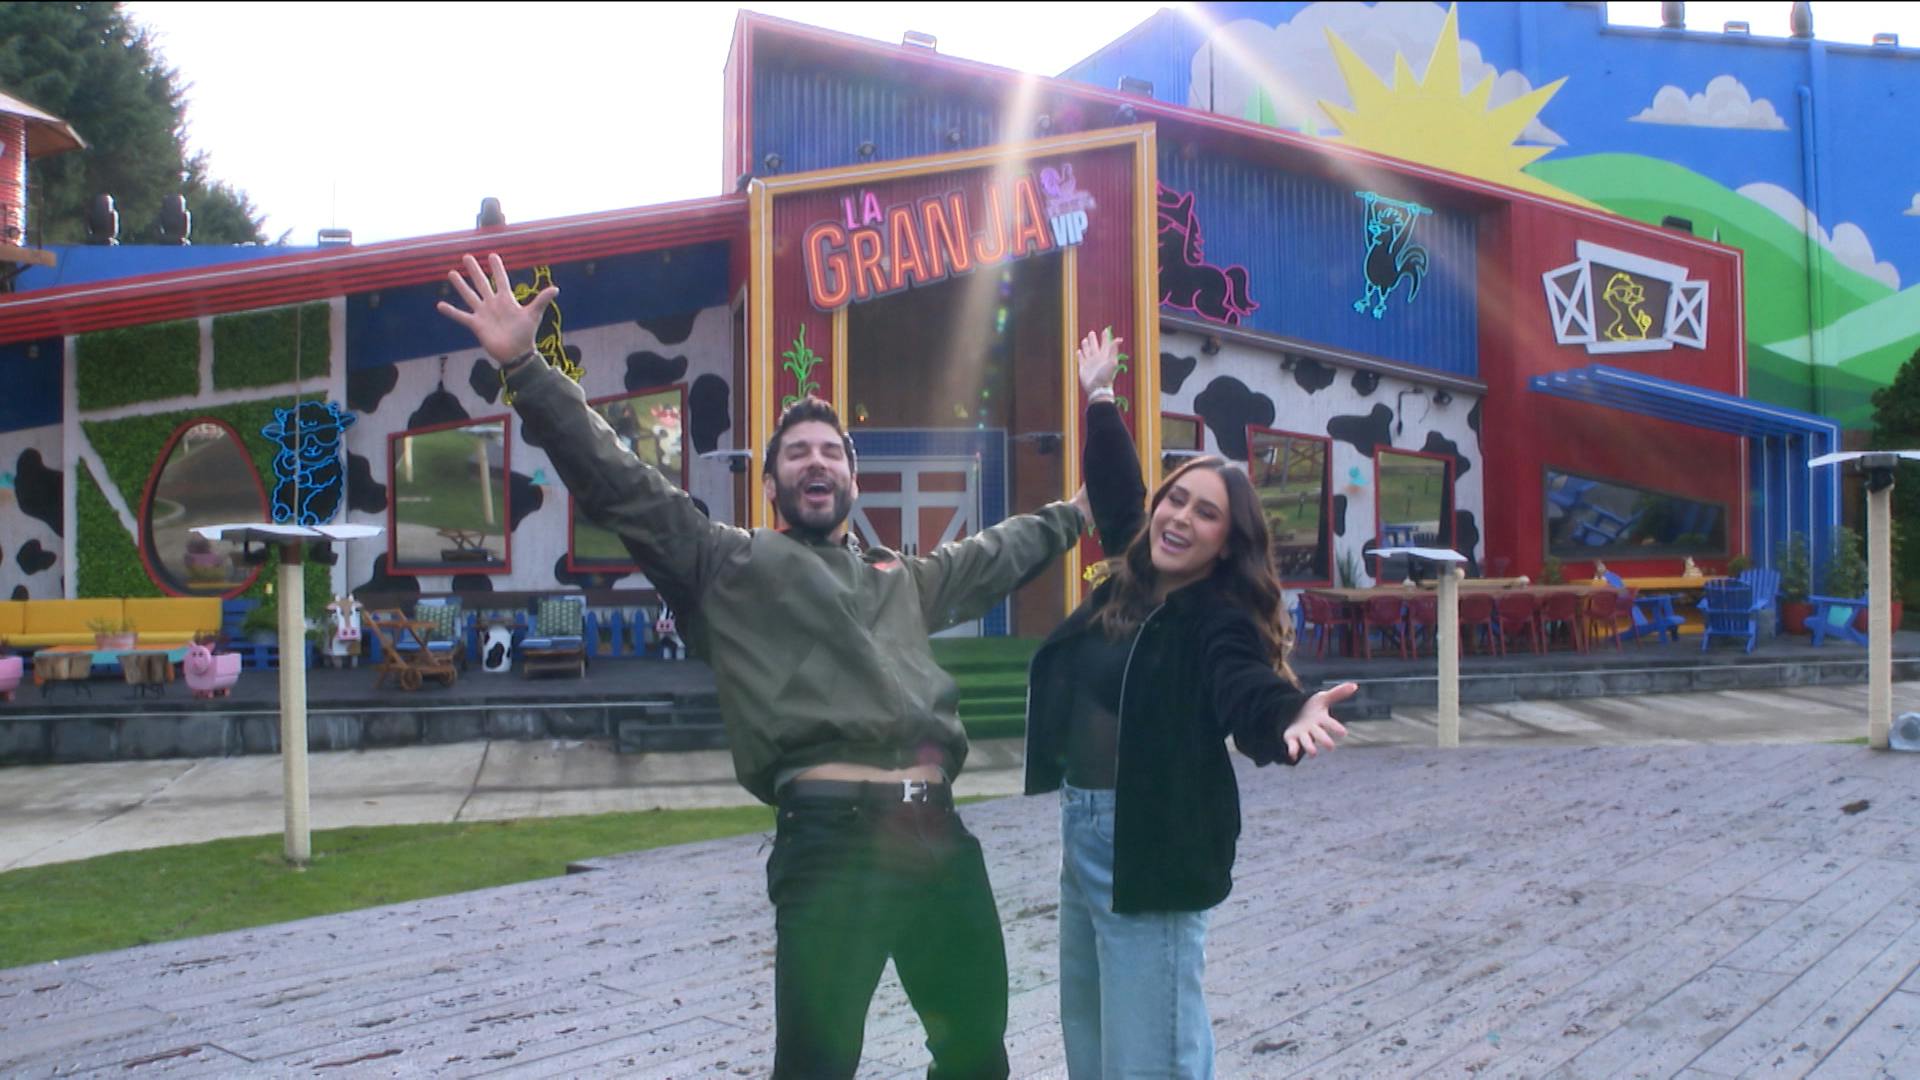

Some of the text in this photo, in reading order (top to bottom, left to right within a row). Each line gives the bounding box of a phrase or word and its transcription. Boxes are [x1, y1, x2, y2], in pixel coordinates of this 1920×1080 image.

[844, 191, 883, 230] LA
[1050, 209, 1088, 247] VIP
[806, 174, 1050, 308] GRANJA
